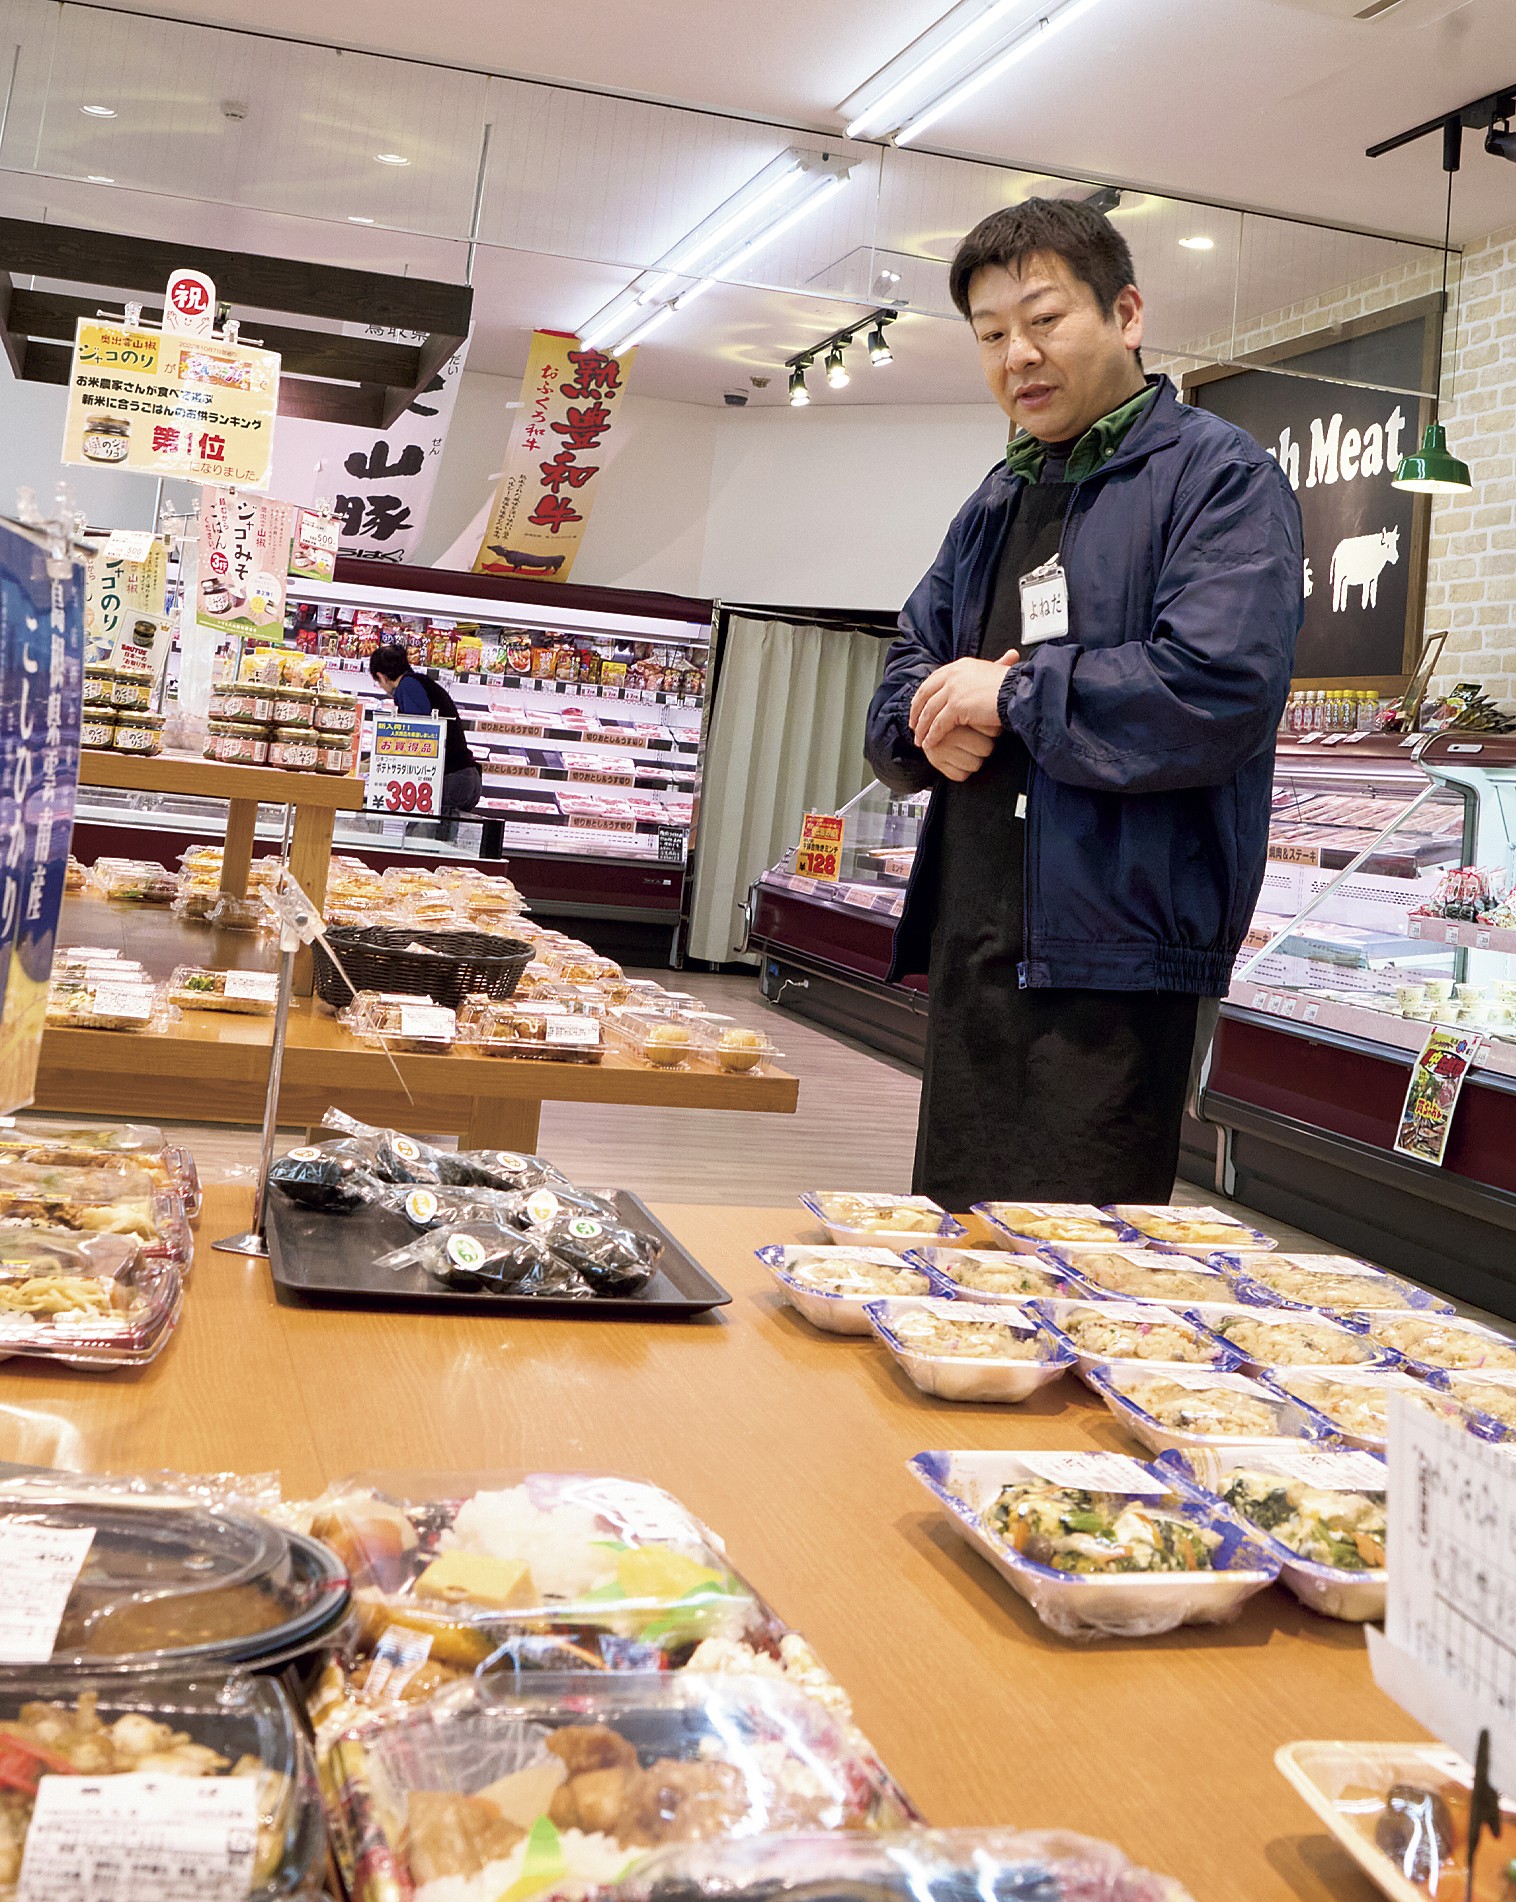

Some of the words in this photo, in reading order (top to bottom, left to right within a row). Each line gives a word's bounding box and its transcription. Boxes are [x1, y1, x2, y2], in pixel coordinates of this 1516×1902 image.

[172, 283, 207, 313] 祝
[101, 335, 157, 350] 奥出雲山椒
[79, 344, 154, 368] ジャコのり
[164, 363, 176, 374] が
[76, 375, 213, 405] お米農家さんが食べて選ぶ
[81, 393, 262, 430] 新米に合うごはんのお供ランキング
[521, 364, 559, 451] おふくろ和牛
[152, 425, 226, 461] 第1位
[429, 438, 442, 455] せん
[528, 350, 622, 534] 熟豊和牛
[1305, 405, 1406, 488] Meat
[189, 461, 260, 481] になりました。
[127, 546, 142, 555] 500
[234, 502, 257, 581] ジャコみそ
[317, 534, 334, 545] 500
[1029, 593, 1062, 620] よねだ
[481, 723, 540, 735] 切りおとし&うす切り
[586, 733, 644, 746] 切りおとし&うす切り
[381, 741, 432, 753] お買得品
[483, 764, 536, 776] りおとし&うす切り
[572, 772, 631, 785] 切りおとし&うす切り
[372, 780, 433, 813] ¥398
[573, 818, 632, 831] 切りおとし&うす切り
[799, 852, 836, 876] ¥128
